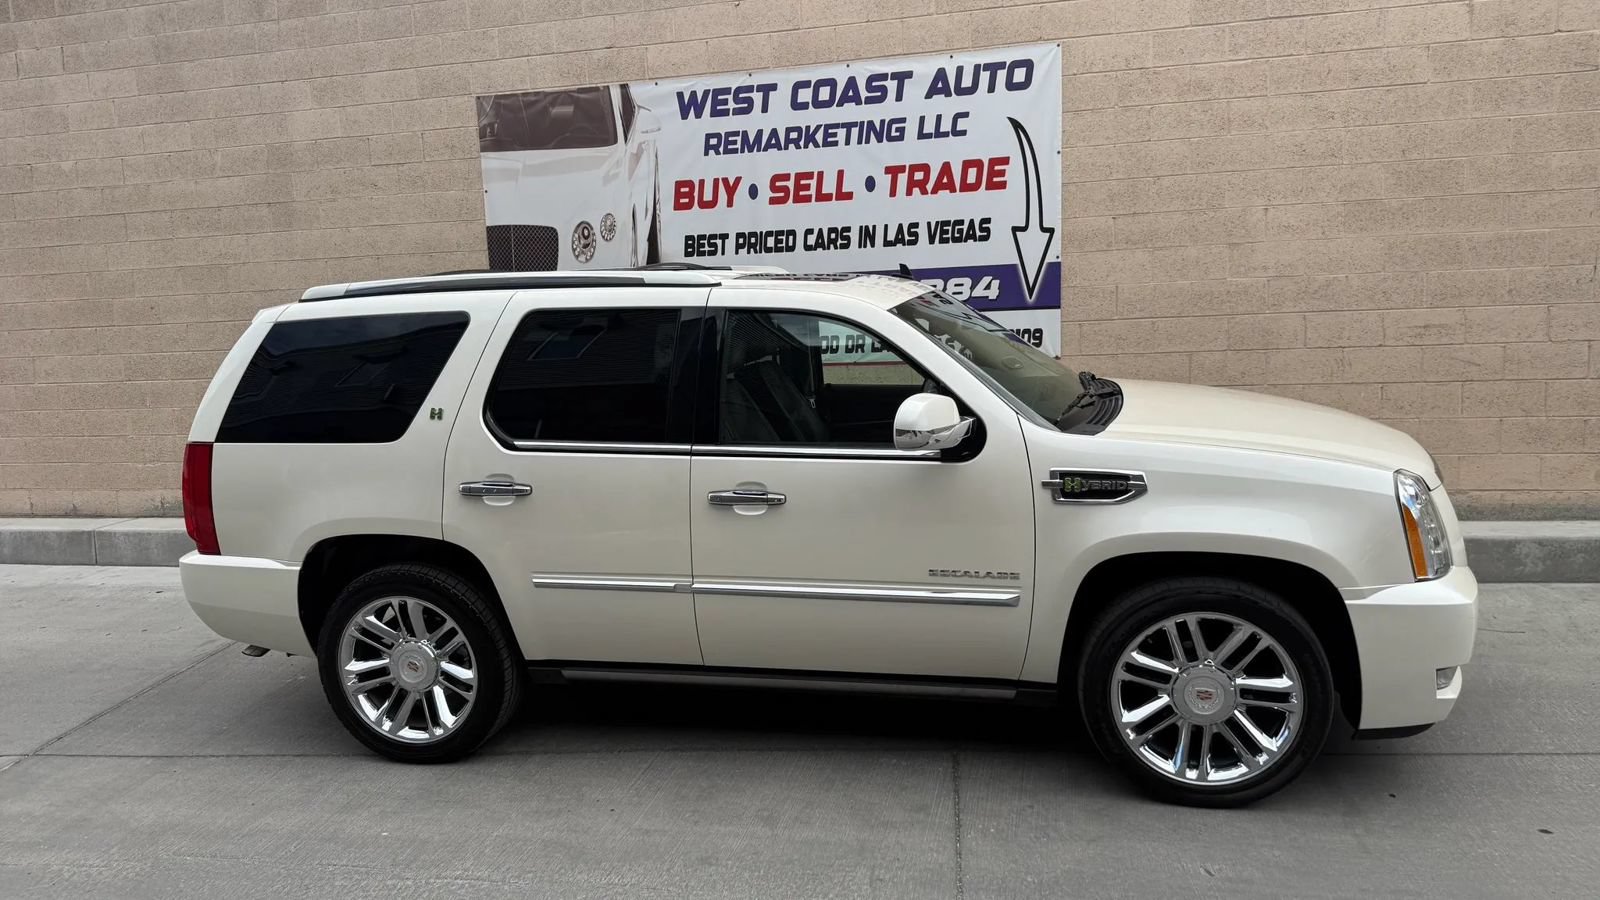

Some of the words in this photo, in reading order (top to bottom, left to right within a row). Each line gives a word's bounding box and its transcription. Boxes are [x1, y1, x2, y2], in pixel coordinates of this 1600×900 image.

[675, 83, 777, 120] WEST
[790, 71, 914, 111] COAST
[925, 58, 1035, 99] AUTO
[703, 117, 906, 156] REMARKETING
[916, 112, 970, 141] LLC
[673, 176, 743, 211] BUY
[768, 170, 854, 205] SELL
[884, 157, 1010, 198] TRADE
[683, 233, 729, 258] BEST
[734, 229, 797, 255] PRICED
[802, 226, 852, 252] CARS
[858, 225, 877, 249] IN
[882, 221, 920, 248] LAS
[926, 217, 992, 245] VEGAS
[845, 335, 866, 353] DR
[928, 569, 1020, 580] ESCALADE
